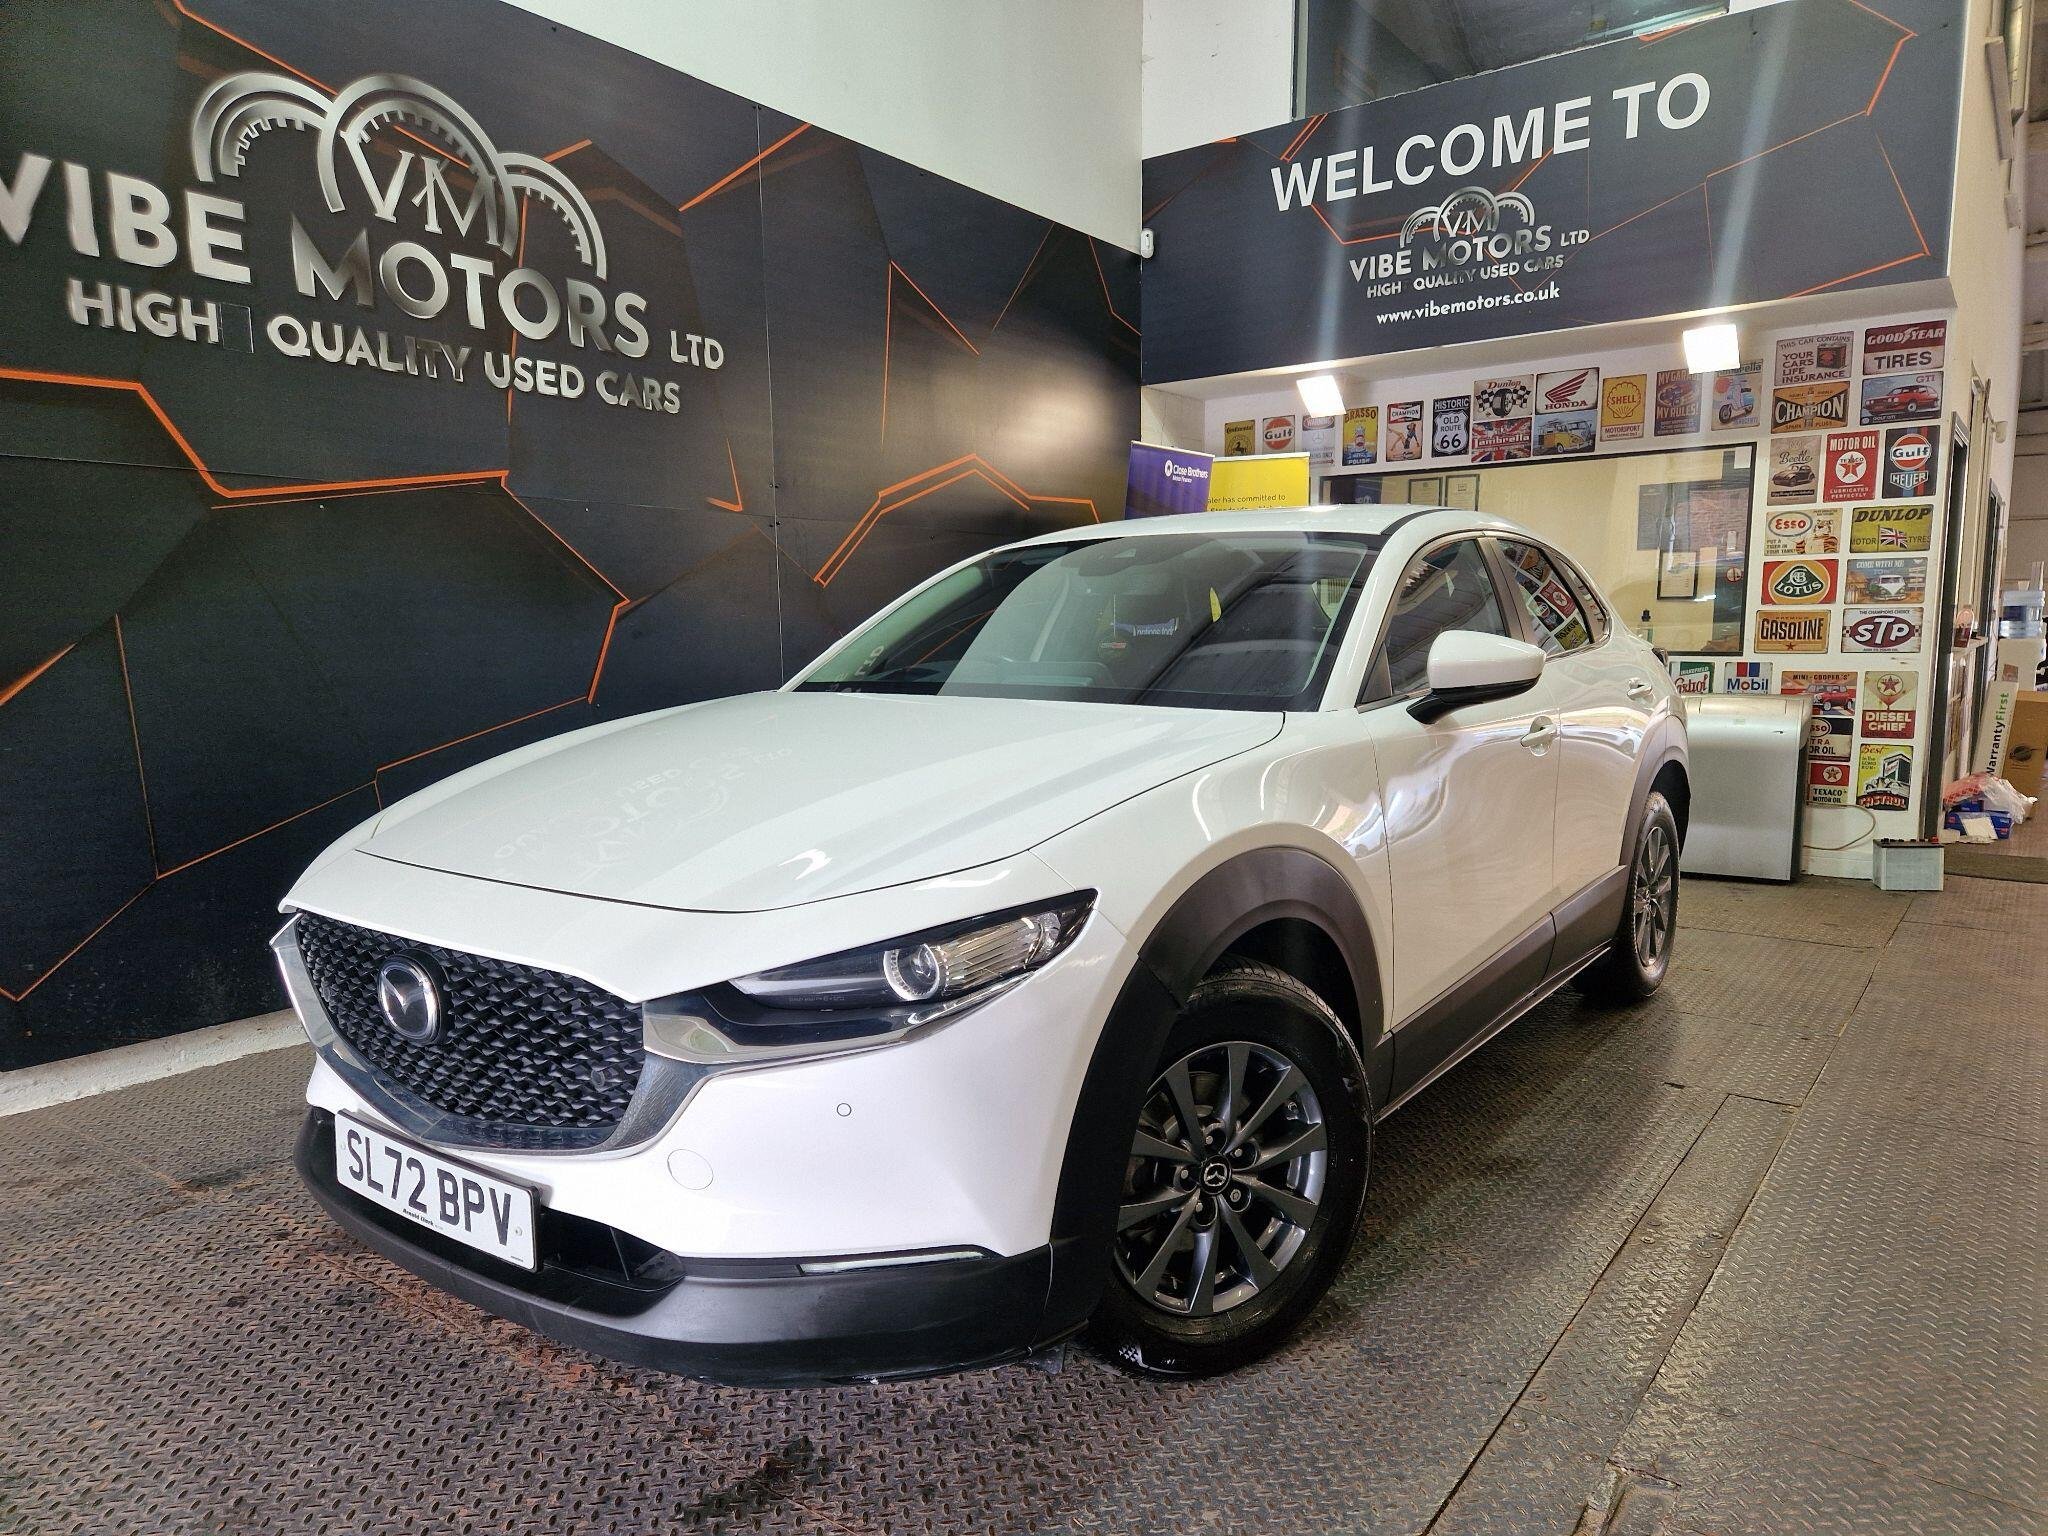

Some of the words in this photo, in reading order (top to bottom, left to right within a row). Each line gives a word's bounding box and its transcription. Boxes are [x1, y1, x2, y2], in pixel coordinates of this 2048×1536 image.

[1270, 96, 1591, 211] WELCOME
[1612, 73, 1711, 140] TO
[0, 153, 251, 284] VIBE
[291, 212, 649, 357] MOTORS
[670, 330, 724, 369] LTD
[1349, 249, 1412, 284] VIBE
[1423, 225, 1551, 271] MOTORS
[1560, 229, 1590, 247] LTD
[1367, 281, 1401, 298] HIGH
[1413, 268, 1476, 291] QUALITY
[1480, 262, 1520, 280] USED
[1524, 254, 1564, 273] CARS
[1377, 281, 1560, 324] www.vibemotors.co.uk
[1867, 326, 1944, 345] GOODYEAR
[68, 278, 219, 343] HIGH
[267, 315, 472, 382] QUALITY
[484, 351, 586, 399] USED
[596, 369, 681, 414] CARS
[1782, 351, 1813, 360] YOUR
[1874, 351, 1932, 369] TIRES
[1782, 368, 1805, 376] LIFE
[1782, 370, 1846, 383] INSURANCE
[1916, 374, 1936, 383] GTI
[1658, 372, 1670, 386] MY
[1434, 399, 1470, 410] HISTORIC
[1545, 399, 1588, 410] HONDA
[1611, 394, 1636, 405] SHELL
[1657, 406, 1669, 419] MY
[1775, 393, 1845, 423] CHAMPION
[1443, 416, 1460, 424] OLD
[1265, 428, 1293, 440] Gulf
[1605, 424, 1640, 434] MOTORSPORT
[1440, 433, 1461, 449] 66
[1830, 437, 1860, 451] MOTOR
[1862, 435, 1876, 449] OIL
[1892, 445, 1930, 458] Gulf
[1173, 465, 1187, 475] Close
[1187, 467, 1209, 479] Brothers
[1892, 472, 1927, 488] HEUER
[1237, 494, 1276, 503] committed
[1855, 507, 1933, 522] DUNLOP
[1852, 537, 1877, 545] MOTOR
[1908, 535, 1931, 543] TYRES
[1856, 560, 1874, 568] COME
[1875, 560, 1892, 568] WITH
[1776, 582, 1822, 595] LOTUS
[1761, 617, 1824, 640] GASOLINE
[1854, 617, 1909, 645] STP
[1727, 678, 1769, 690] Mobil
[1865, 711, 1911, 721] DIESEL
[1869, 722, 1906, 731] CHIEF
[1822, 746, 1836, 754] OIL
[1813, 788, 1843, 796] TEXACO
[347, 1129, 428, 1214] SL72
[437, 1167, 512, 1247] BPV
